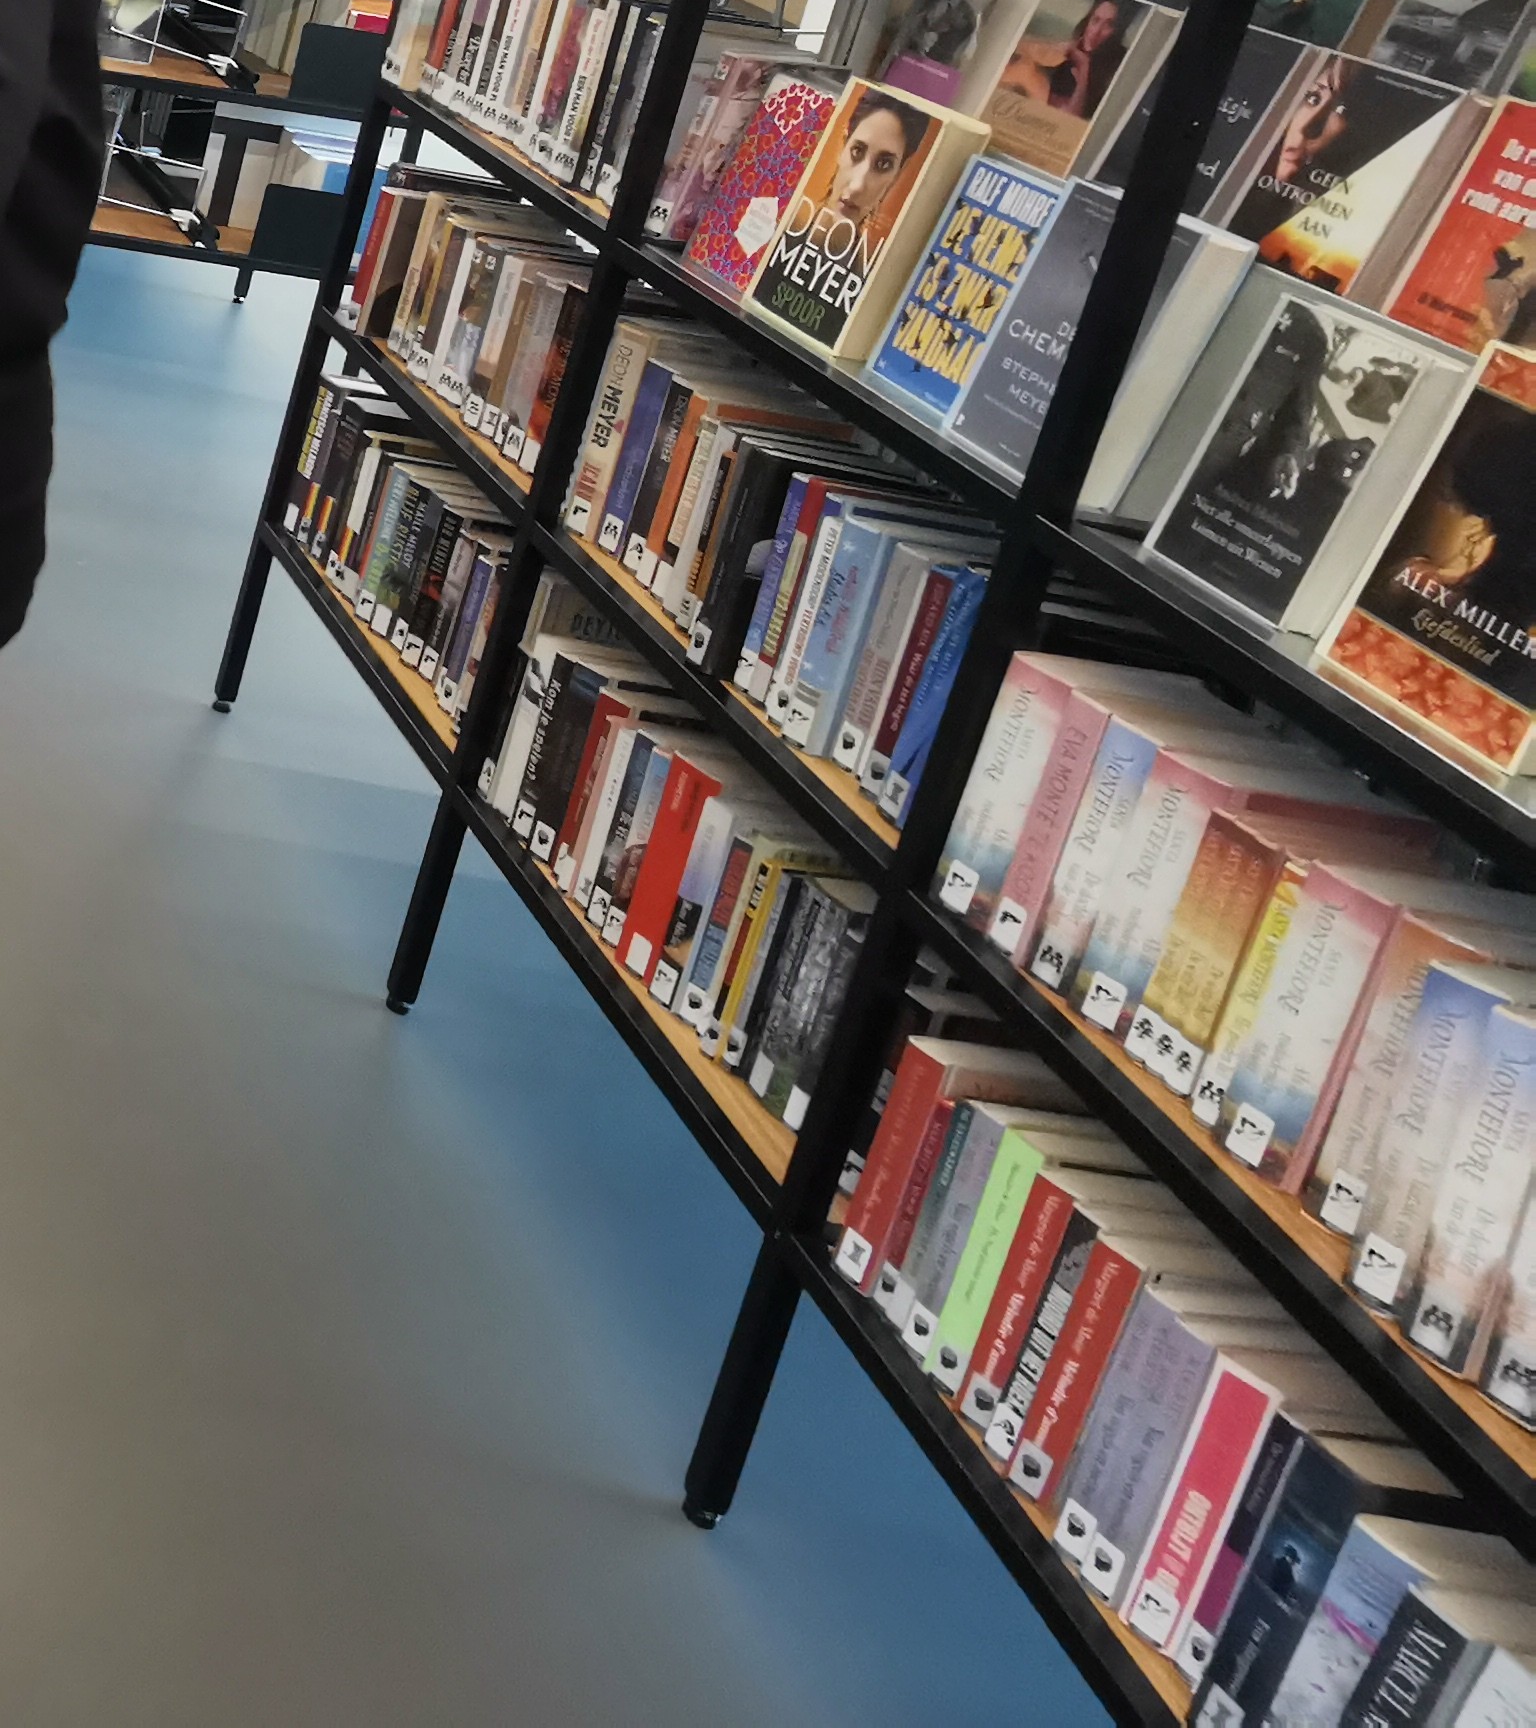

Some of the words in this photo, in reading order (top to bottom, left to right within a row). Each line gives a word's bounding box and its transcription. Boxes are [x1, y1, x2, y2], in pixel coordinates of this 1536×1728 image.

[967, 166, 1009, 207] RALF
[1257, 173, 1355, 223] ONTKOMEN
[1308, 167, 1355, 197] GEEN
[786, 195, 885, 279] DEON
[1299, 214, 1334, 241] AAN
[769, 233, 864, 316] MEYER
[771, 280, 826, 332] SPOOR
[1009, 318, 1068, 364] CHEM
[591, 384, 625, 450] MEYER
[1009, 383, 1049, 416] MEYE
[1394, 565, 1454, 610] ALEX
[543, 678, 562, 713] Kom
[984, 687, 1038, 784] MONTEFIORE
[1066, 725, 1089, 761] EVA
[1045, 767, 1074, 828] MONTE
[1074, 750, 1135, 855] MONTEFIORE
[1128, 783, 1189, 891] MONTEFIORE
[1278, 902, 1348, 1017] MONTEFIORE
[1398, 1010, 1469, 1135] MONTEFIORE
[1454, 1052, 1536, 1183] MONTEFIORE
